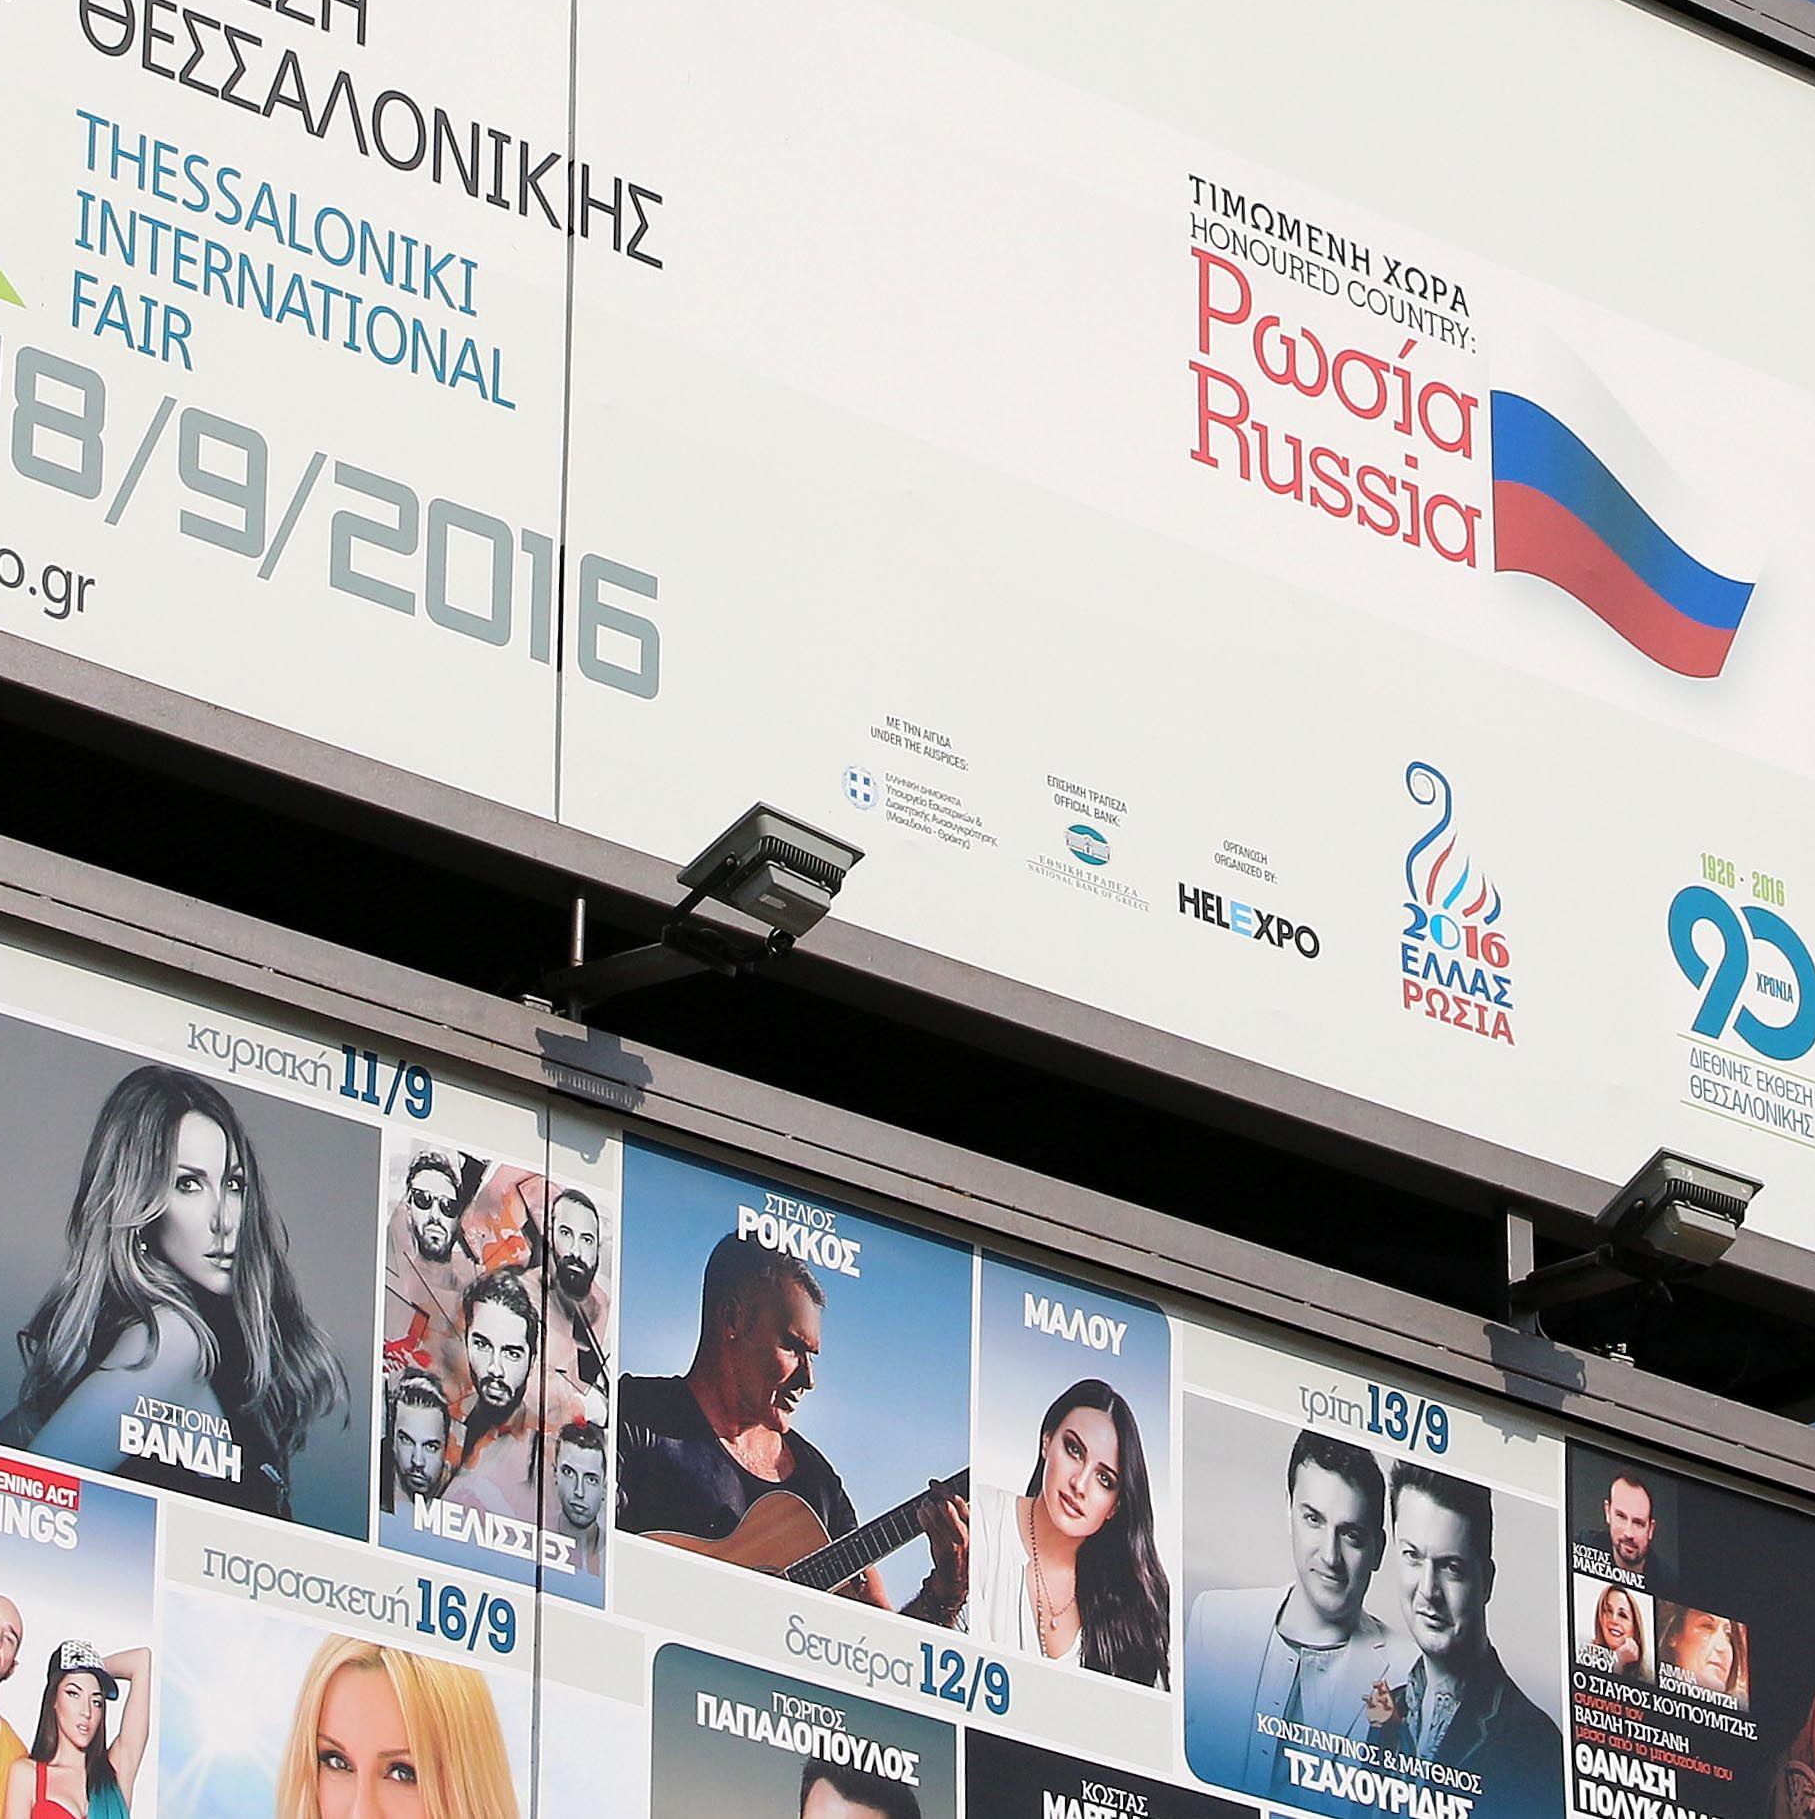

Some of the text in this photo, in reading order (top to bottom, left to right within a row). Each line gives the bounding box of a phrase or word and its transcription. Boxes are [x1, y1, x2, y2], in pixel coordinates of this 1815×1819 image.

[77, 110, 478, 317] THESSALONIKI
[1188, 175, 1470, 317] ΤΙΜΩΜΕΝΗ ΧΩΡΑ
[74, 192, 515, 409] INTERNATIONAL
[1190, 212, 1478, 353] HONOURED COUNTRY:
[71, 269, 193, 369] FAIR
[1189, 246, 1480, 461] Ρωσία
[1189, 361, 1482, 568] Russia
[871, 727, 902, 746] UNDER
[904, 738, 921, 754] THE
[1054, 794, 1092, 816] OFFICIAL
[1214, 852, 1262, 880] ORGANIZED
[1700, 852, 1785, 907] 1926 2016
[1178, 882, 1320, 959] HELEXPO
[1403, 901, 1510, 969] 2016
[1402, 943, 1514, 1009] ΕΛΛΑΣ
[1756, 971, 1794, 1004] ΧΡΟΝΙΑ
[1403, 978, 1515, 1045] ΡΩΣΙΑ
[187, 1022, 434, 1121] κυριακή 11/9
[1689, 1047, 1814, 1108] ΔΙΕΘΝΗΣ ΕΚΘΕΣΗ
[1690, 1075, 1815, 1139] ΘΕΣΣΑΛΟΝΙΚΗΣ
[737, 1204, 862, 1278] ΡΟΚΚΟΣ
[763, 1192, 837, 1234] ΣΤΕΛΙΟΣ
[1024, 1292, 1127, 1356] ΜΑΛΟΥ
[119, 1414, 243, 1483] ΒΑΝΔΗ
[133, 1394, 232, 1440] ΔΕΣΠΟΙΝΑ
[1298, 1382, 1450, 1456] τρίτη 13/9
[45, 1483, 79, 1508] ACT
[1573, 1542, 1612, 1566] ΚΩΣΤΑΣ
[1573, 1554, 1645, 1589] ΜΑΚΕΔΟΝΑΣ
[203, 1544, 516, 1654] παρασκευή 16/9
[785, 1614, 1010, 1716] δευτέρα 12/9
[1575, 1651, 1615, 1674] ΚΟΡΟΥ
[1589, 1675, 1652, 1709] ΣΤΑΥΡΟΣ
[695, 1692, 920, 1787] ΠΑΠΑΔΟΠΟΥΛΟΣ
[770, 1692, 848, 1731] ΓΙΩΡΓΟΣ
[1574, 1705, 1689, 1753] ΒΑΣΙΛΗ ΤΣΙΤΣΑΝΗ
[1257, 1713, 1483, 1795] ΚΩΝΣΤΑΝΤΙΝΟΣ & ΜΑΤΘΑΙΟΣ
[1575, 1744, 1677, 1800] ΘΑΝΑΣΗ
[1081, 1780, 1148, 1816] ΚΩΣΤΑΣ
